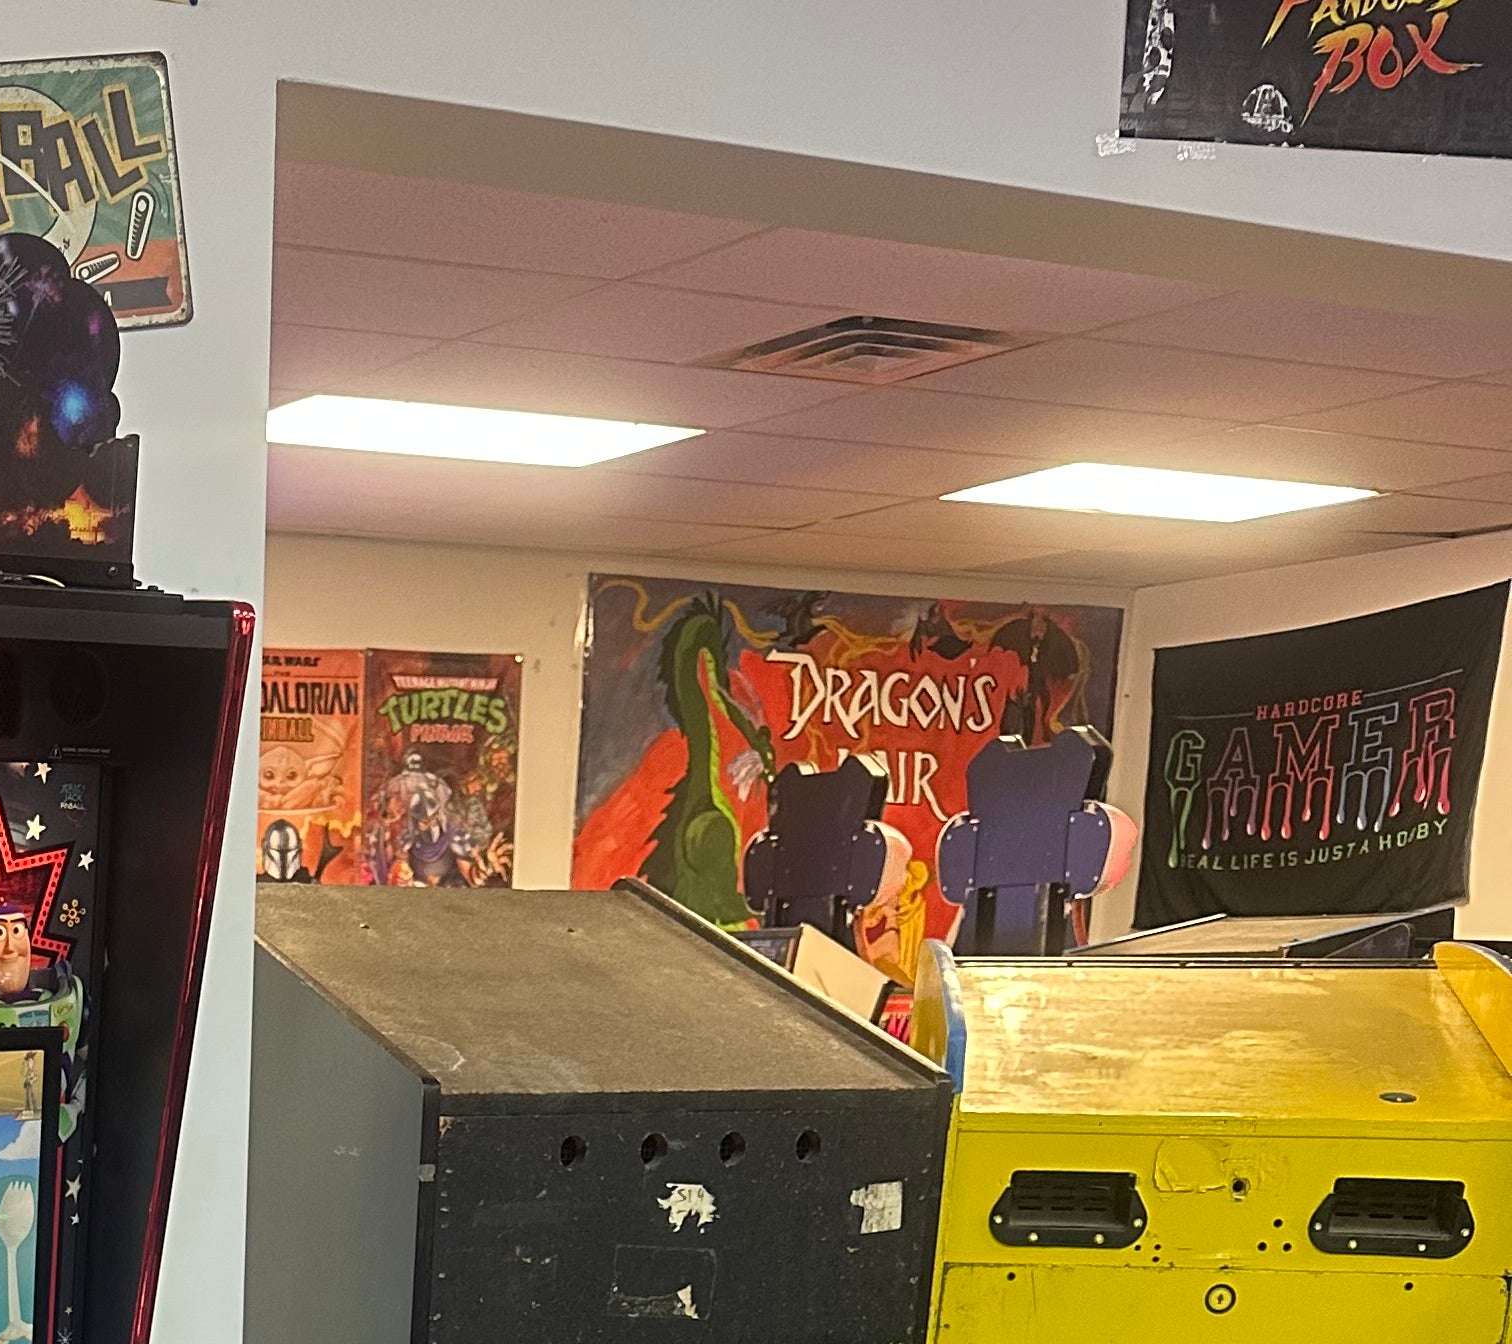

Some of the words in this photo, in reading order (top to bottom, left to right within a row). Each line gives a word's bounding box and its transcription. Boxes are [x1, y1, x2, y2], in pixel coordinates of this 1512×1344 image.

[1301, 12, 1484, 127] BOX
[378, 689, 508, 734] TURTLES
[765, 649, 998, 741] DRAGON'S
[1256, 690, 1363, 721] HARDCORE
[1164, 688, 1456, 815] GAMER
[1229, 851, 1273, 871] LIFE
[1280, 850, 1298, 868] IS
